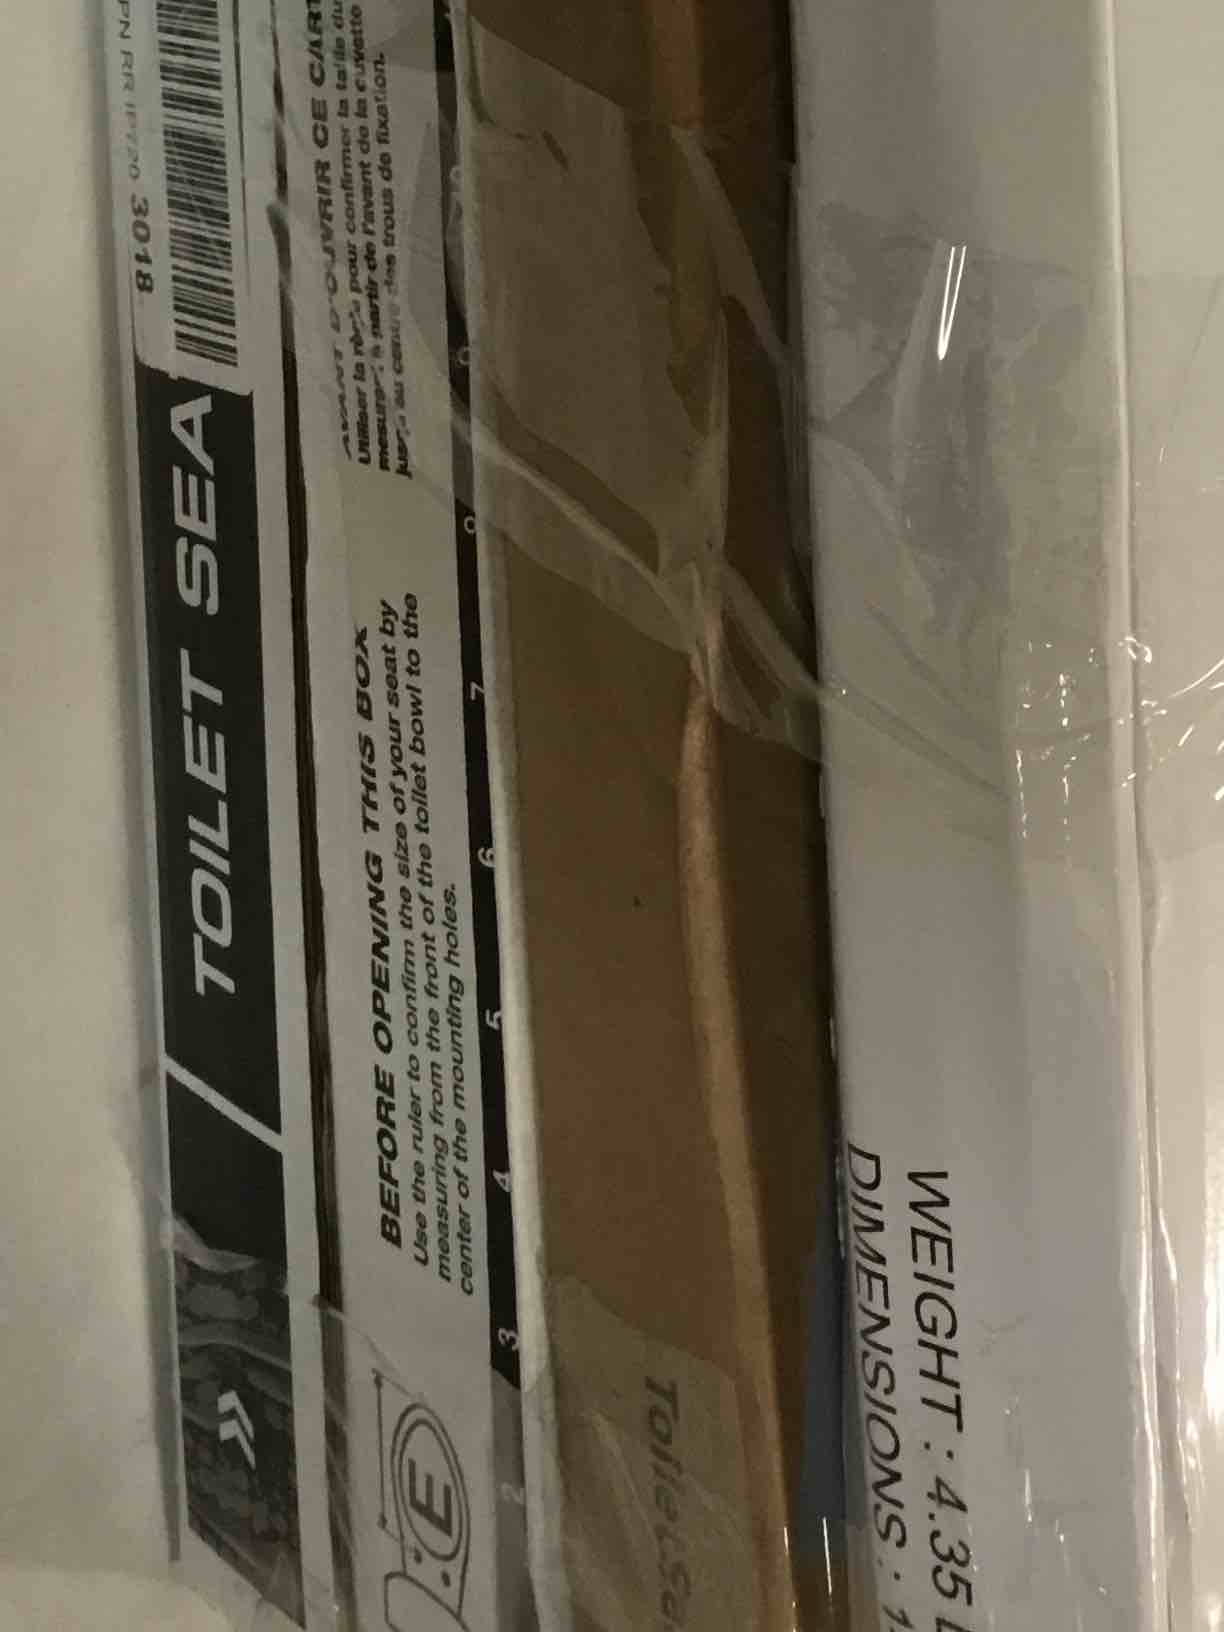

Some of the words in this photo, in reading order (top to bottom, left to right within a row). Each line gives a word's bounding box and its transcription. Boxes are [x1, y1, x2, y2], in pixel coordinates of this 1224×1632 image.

[311, 97, 328, 148] CE
[356, 125, 371, 155] de
[340, 127, 357, 235] confirmer
[377, 151, 393, 182] de
[130, 193, 154, 295] 3018
[380, 188, 396, 248] trous
[346, 240, 363, 294] pour
[378, 599, 399, 638] by
[401, 592, 420, 640] the
[353, 623, 374, 722] BOX
[381, 644, 400, 709] seat
[404, 648, 421, 678] to
[387, 712, 408, 782] your
[404, 683, 426, 757] bowl
[357, 731, 380, 834] THIS
[388, 780, 407, 816] of
[409, 762, 430, 835] toilet
[180, 648, 236, 998] TOILET
[392, 821, 411, 880] size
[415, 843, 433, 889] the
[397, 885, 413, 931] the
[417, 891, 436, 926] of
[441, 883, 461, 968] holes.
[364, 849, 393, 1056] OPENING
[419, 931, 440, 1000] front
[400, 939, 419, 1048] confirm
[424, 1008, 441, 1053] the
[445, 974, 466, 1112] mounting
[405, 1053, 421, 1082] to
[428, 1061, 445, 1128] from
[406, 1085, 424, 1154] ruler
[451, 1118, 469, 1164] the
[373, 1063, 402, 1250] BEFORE
[411, 1160, 427, 1205] the
[452, 1166, 470, 1200] of
[492, 1169, 512, 1193] 4
[413, 1211, 430, 1267] Use
[429, 1133, 452, 1284] measuring
[457, 1204, 474, 1297] center
[497, 1328, 519, 1352] 3
[408, 1458, 453, 1538] E
[926, 1474, 973, 1607] 4.35
